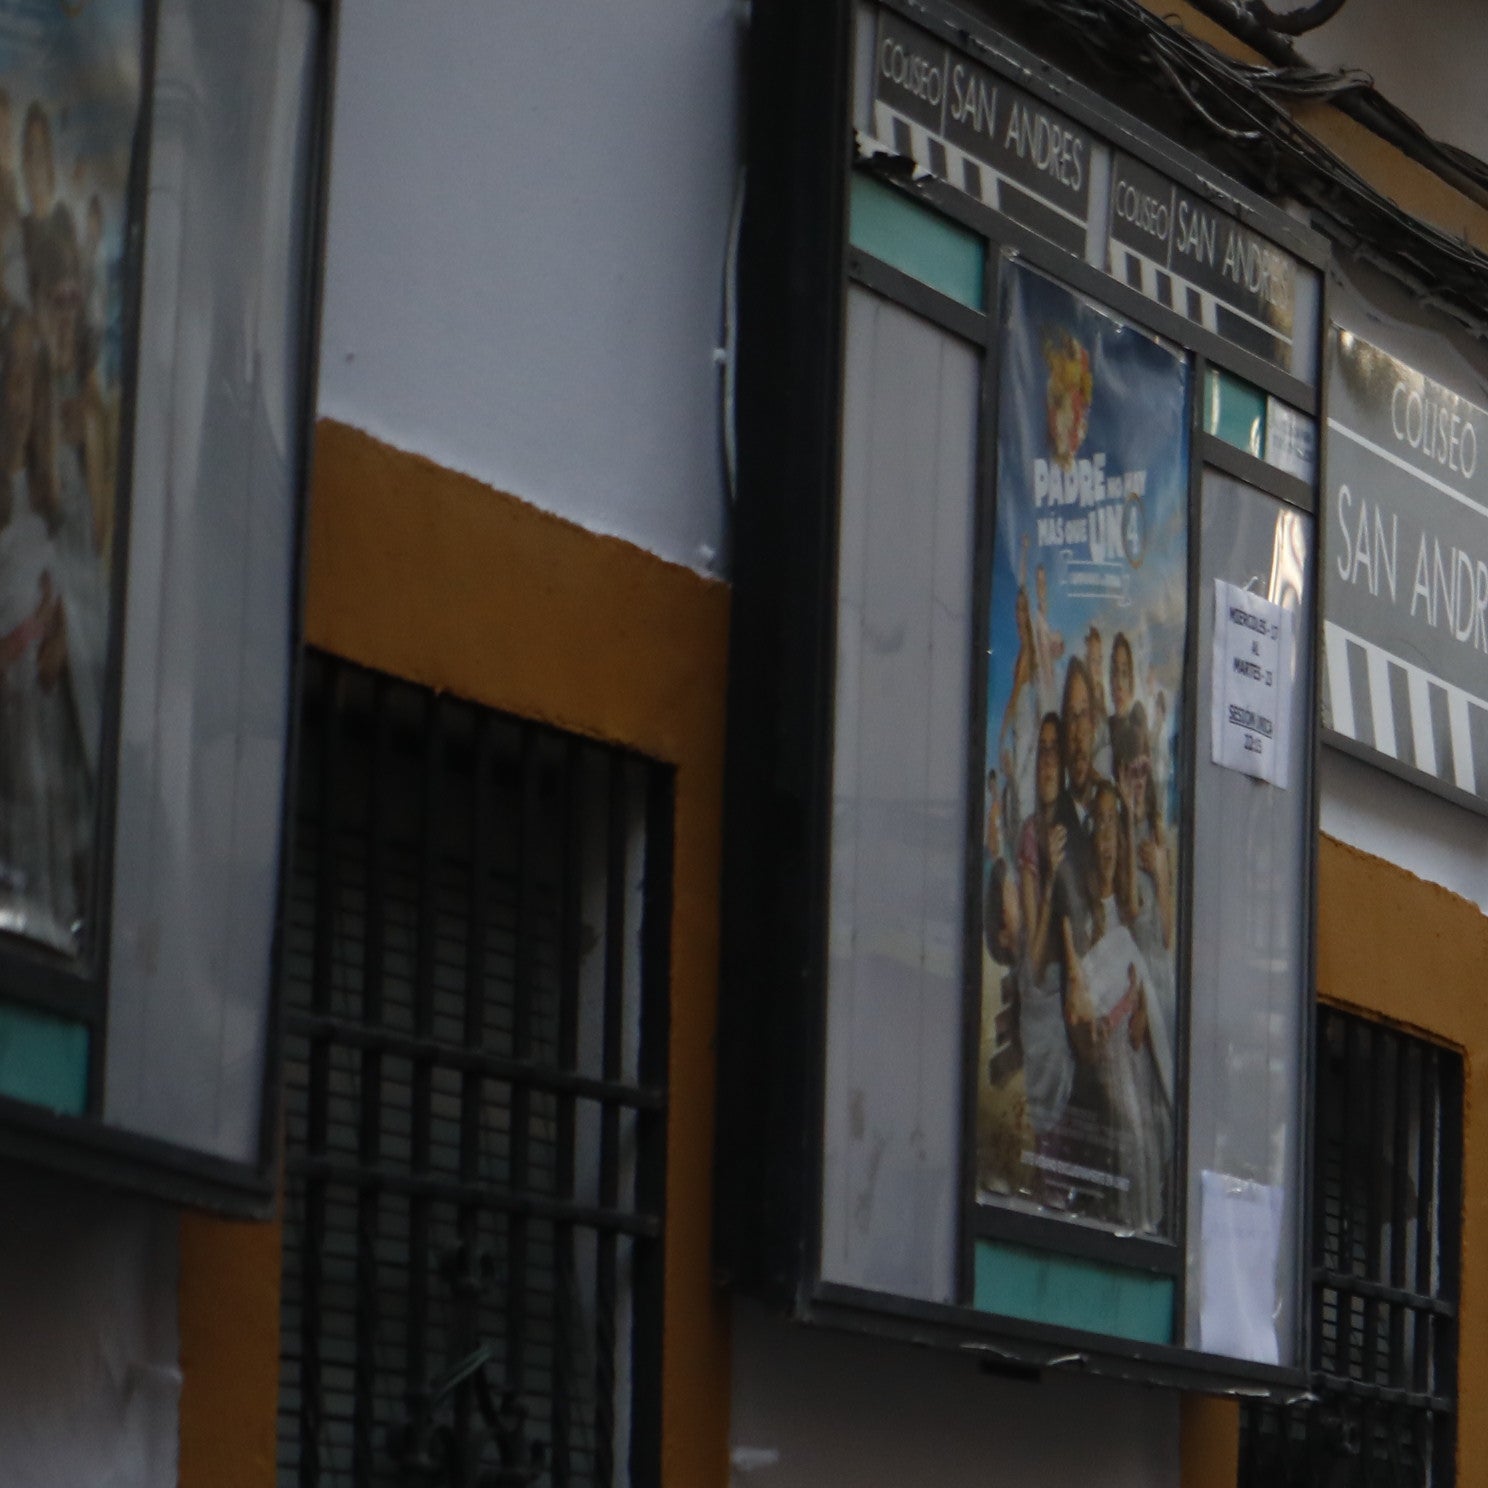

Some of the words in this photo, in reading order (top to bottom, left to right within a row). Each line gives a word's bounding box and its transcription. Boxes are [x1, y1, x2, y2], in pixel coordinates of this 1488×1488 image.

[881, 38, 942, 106] COLISEO
[951, 64, 998, 140] SAN
[1005, 100, 1082, 192] ANDRES
[1115, 180, 1168, 240] COLISEO
[1177, 200, 1216, 269] SAN
[1391, 382, 1477, 479] COLISEO
[1337, 484, 1398, 603] SAN
